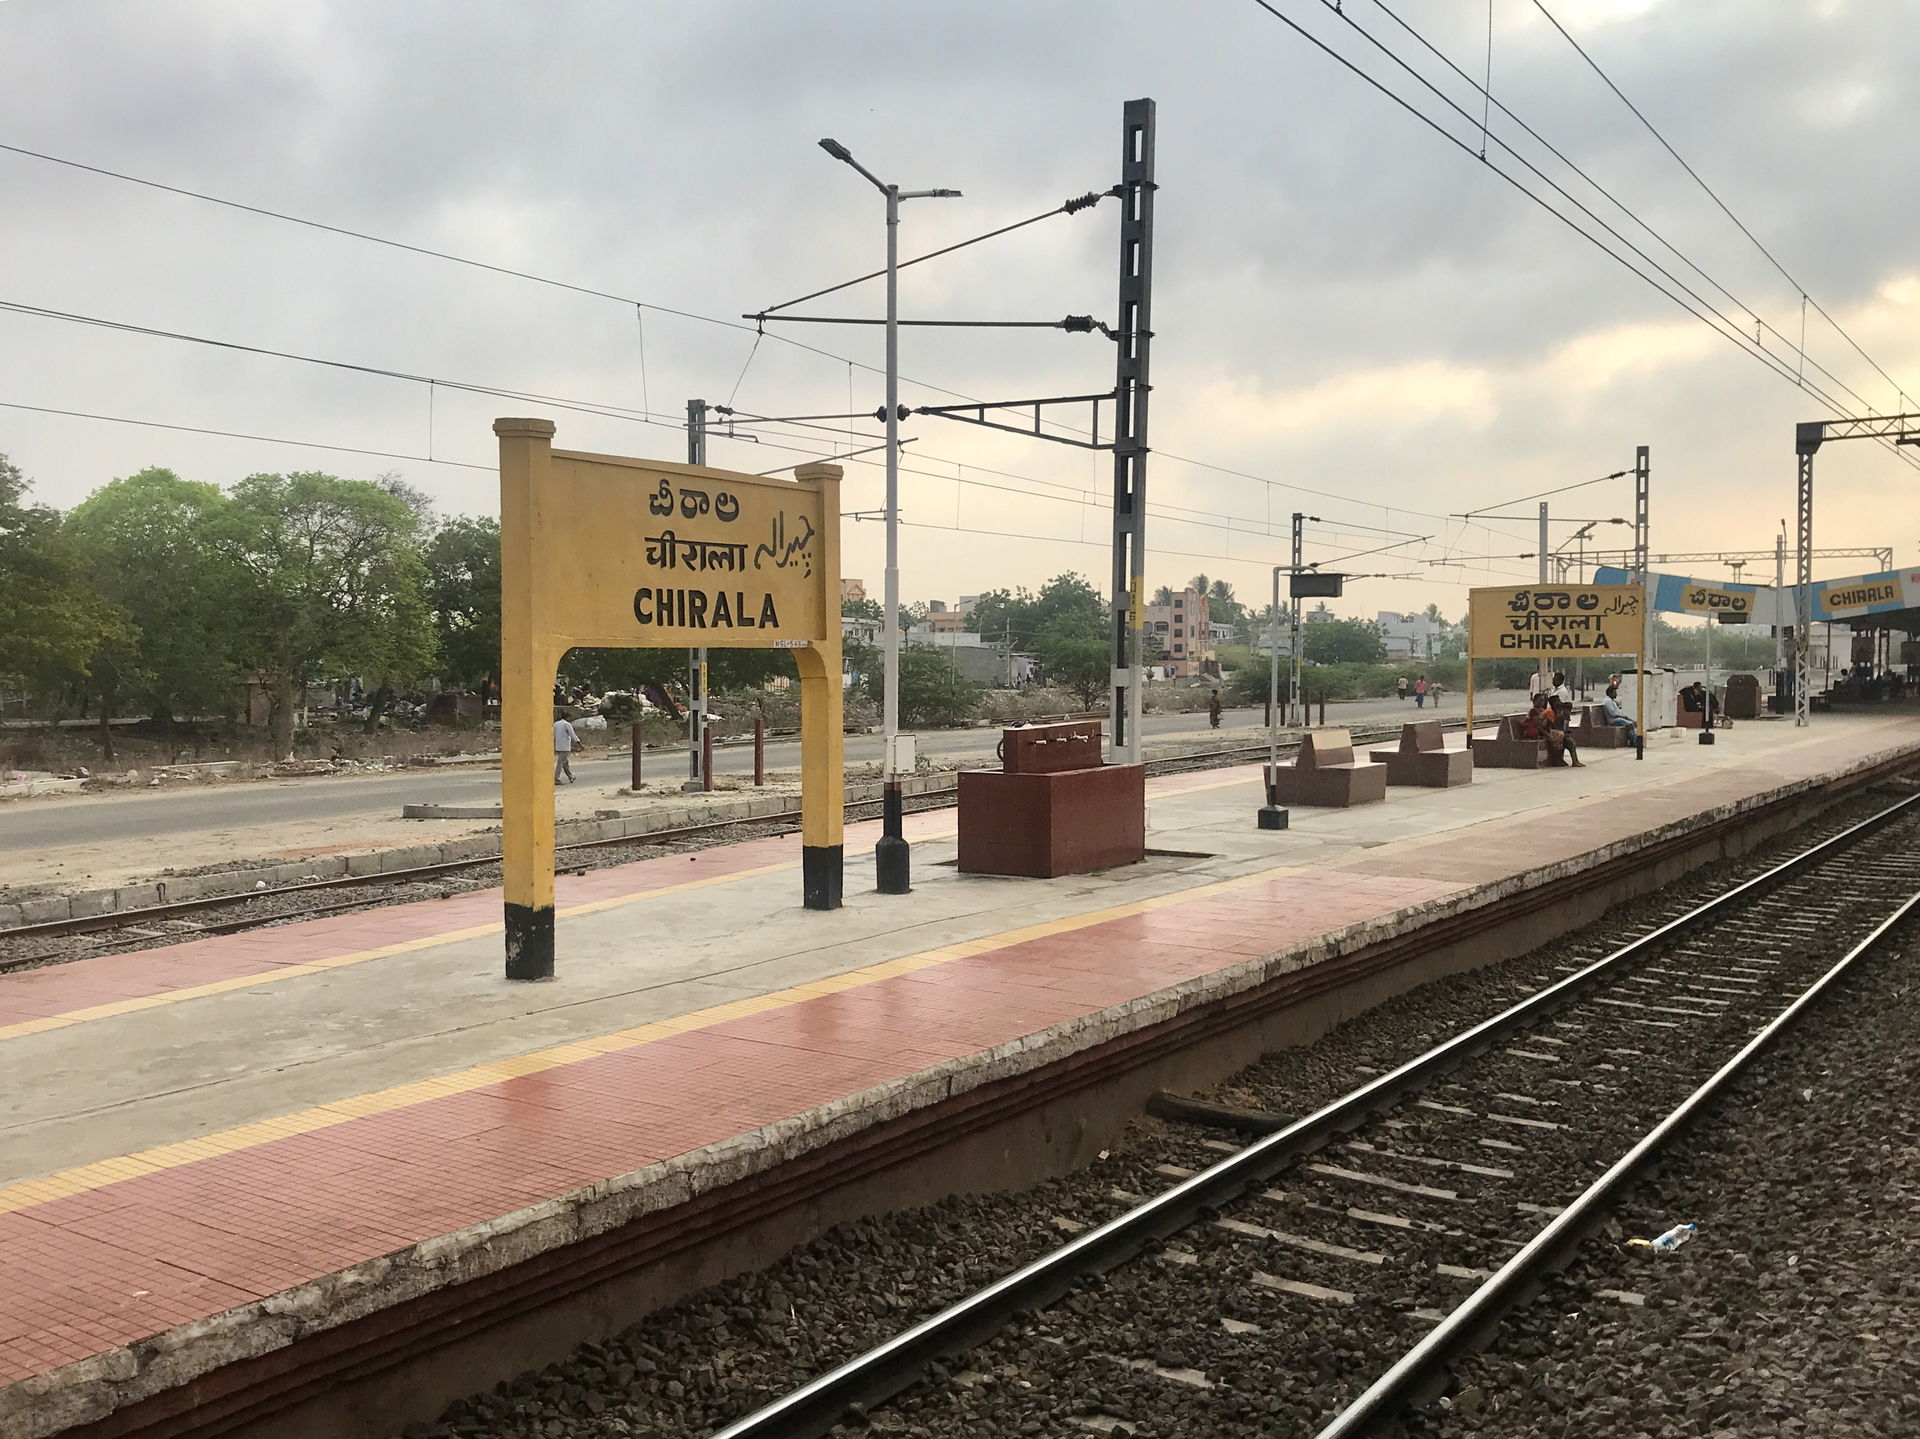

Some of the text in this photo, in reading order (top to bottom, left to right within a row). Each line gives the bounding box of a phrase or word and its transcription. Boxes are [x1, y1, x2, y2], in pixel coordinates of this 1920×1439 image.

[649, 479, 739, 522] చీరాల
[644, 530, 748, 572] चीराला
[1508, 590, 1599, 612] చీరాల
[1689, 589, 1747, 611] చీరాల
[1829, 585, 1894, 606] CHIRALA
[633, 588, 780, 629] CHIRALA
[1505, 610, 1608, 631] चीराला
[1500, 633, 1610, 649] CHIRALA
